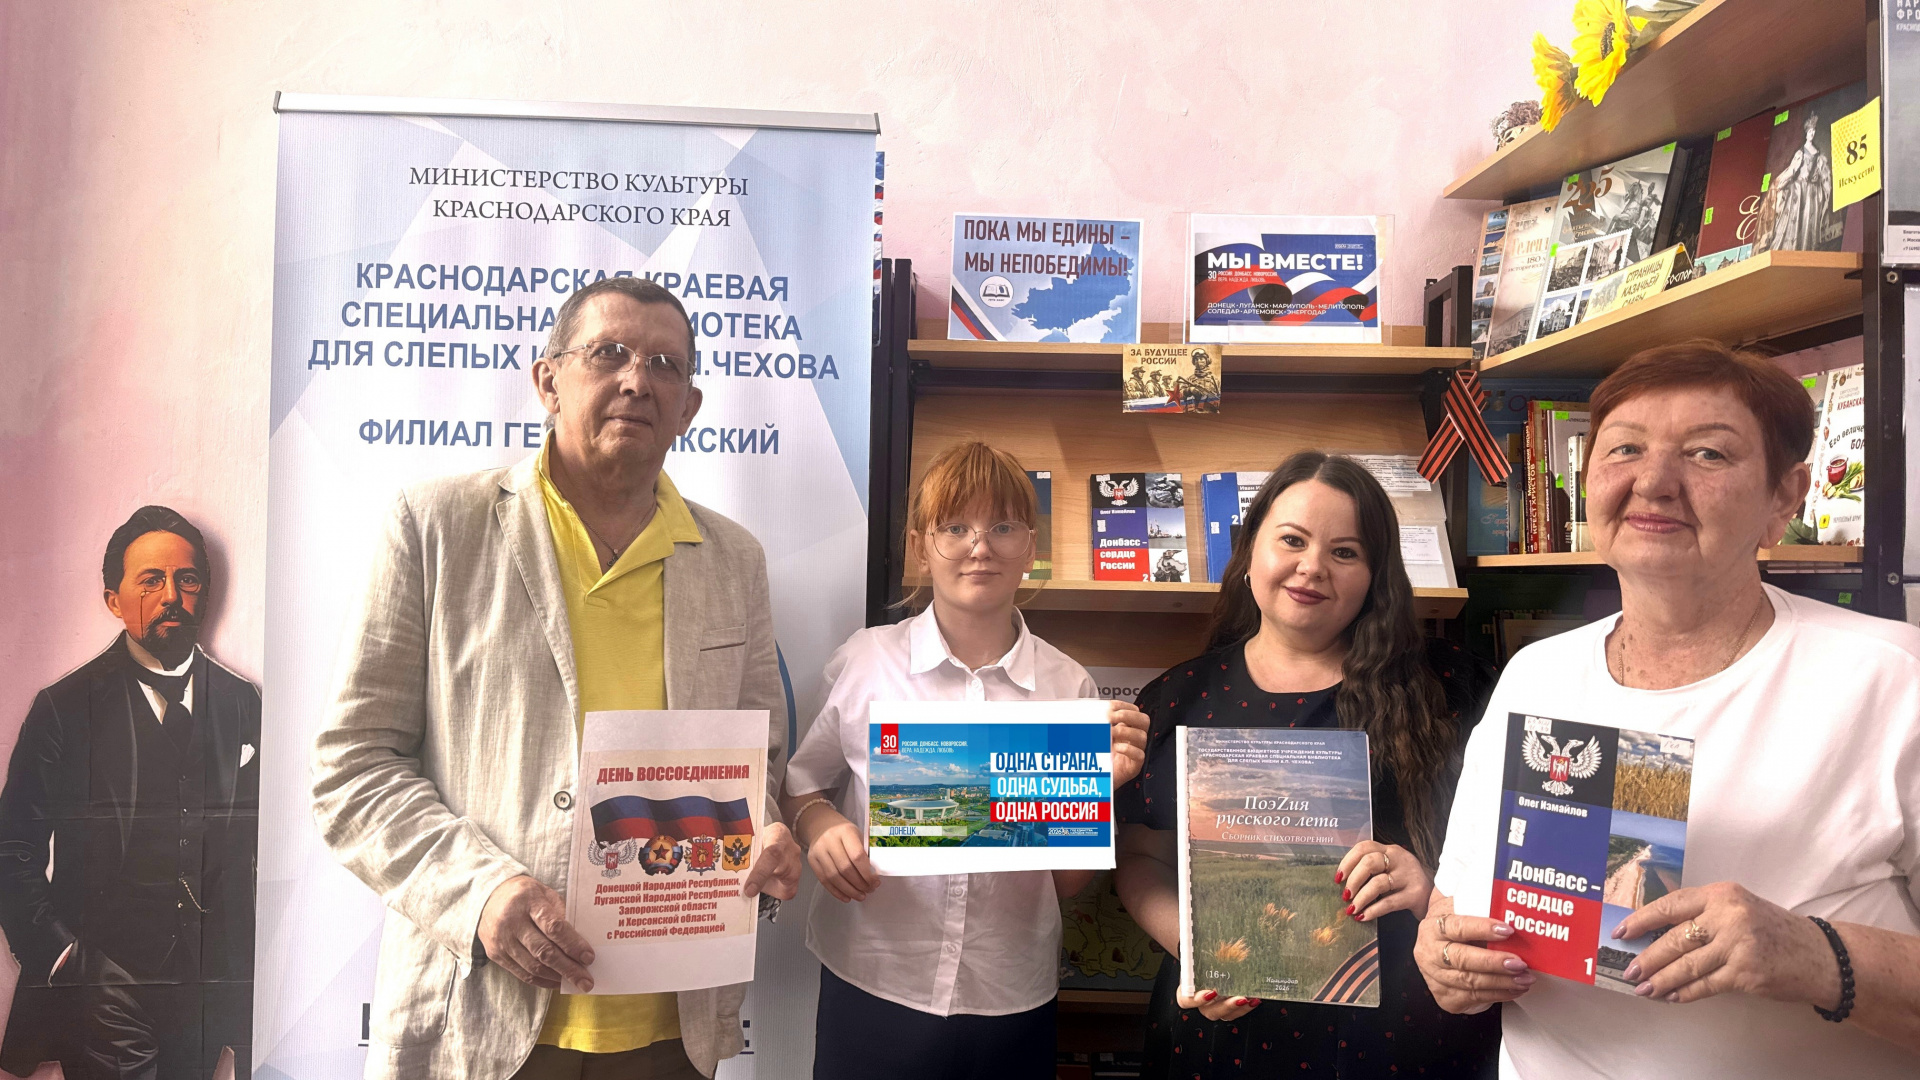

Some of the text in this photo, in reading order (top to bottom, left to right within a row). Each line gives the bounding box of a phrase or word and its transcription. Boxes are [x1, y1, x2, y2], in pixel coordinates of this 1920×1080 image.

[1846, 134, 1867, 166] 85
[409, 166, 749, 198] МИНИСТЕРСТВО КУЛЬТУРЫ
[1838, 164, 1875, 188] Искусство
[432, 198, 731, 228] КРАСНОДАРСКОГО КРАЯ
[963, 219, 1011, 242] ПОКА
[1016, 220, 1046, 243] МЫ
[1052, 222, 1115, 247] ЕДИНЫ
[964, 251, 1128, 279] МЫ НЕПОБЕДИМЫ!
[1207, 252, 1364, 271] МЫ ВМЕСТЕ!
[1626, 258, 1664, 284] СТРАНИЦЫ
[1621, 273, 1659, 298] КАЗАЧЬЕЙ
[341, 301, 557, 333] СПЕЦИАЛЬНА
[308, 340, 373, 371] ДЛЯ
[384, 341, 521, 370] СЛЕПЫХ
[1130, 348, 1188, 357] ЗА БУДУЩЕЕ
[1141, 357, 1177, 365] РОССИИ
[358, 419, 492, 447] ФИЛИАЛ
[1231, 514, 1239, 525] 2
[1100, 538, 1141, 549] Донбасс
[1100, 550, 1136, 559] сердце
[1100, 561, 1135, 570] России
[1142, 573, 1148, 582] 2
[882, 734, 897, 748] 30
[995, 753, 1103, 773] ОДНА СТРАНА,
[597, 764, 750, 785] ДЕНЬ ВОССОЕДИНЕНИЯ
[996, 777, 1103, 798] ОДНА СУДЬБА,
[995, 802, 1099, 821] ОДНА РОССИЯ
[1244, 795, 1310, 811] ПоэZия
[1518, 795, 1588, 818] Олег Измайлов
[1215, 813, 1339, 829] русского лета
[889, 826, 917, 836] ДОНЕЦК
[595, 877, 741, 895] Донецкой Народной Республики,
[1508, 860, 1588, 893] Донбасс
[594, 889, 741, 906] Луганской Народной Республики,
[1506, 887, 1574, 917] сердце
[618, 901, 717, 916] Запорожской области
[618, 912, 716, 927] и Херсонской области
[1504, 909, 1570, 942] России
[607, 923, 726, 939] с Российской Федерацией
[1205, 969, 1231, 980] (16+)
[1584, 957, 1594, 976] 1
